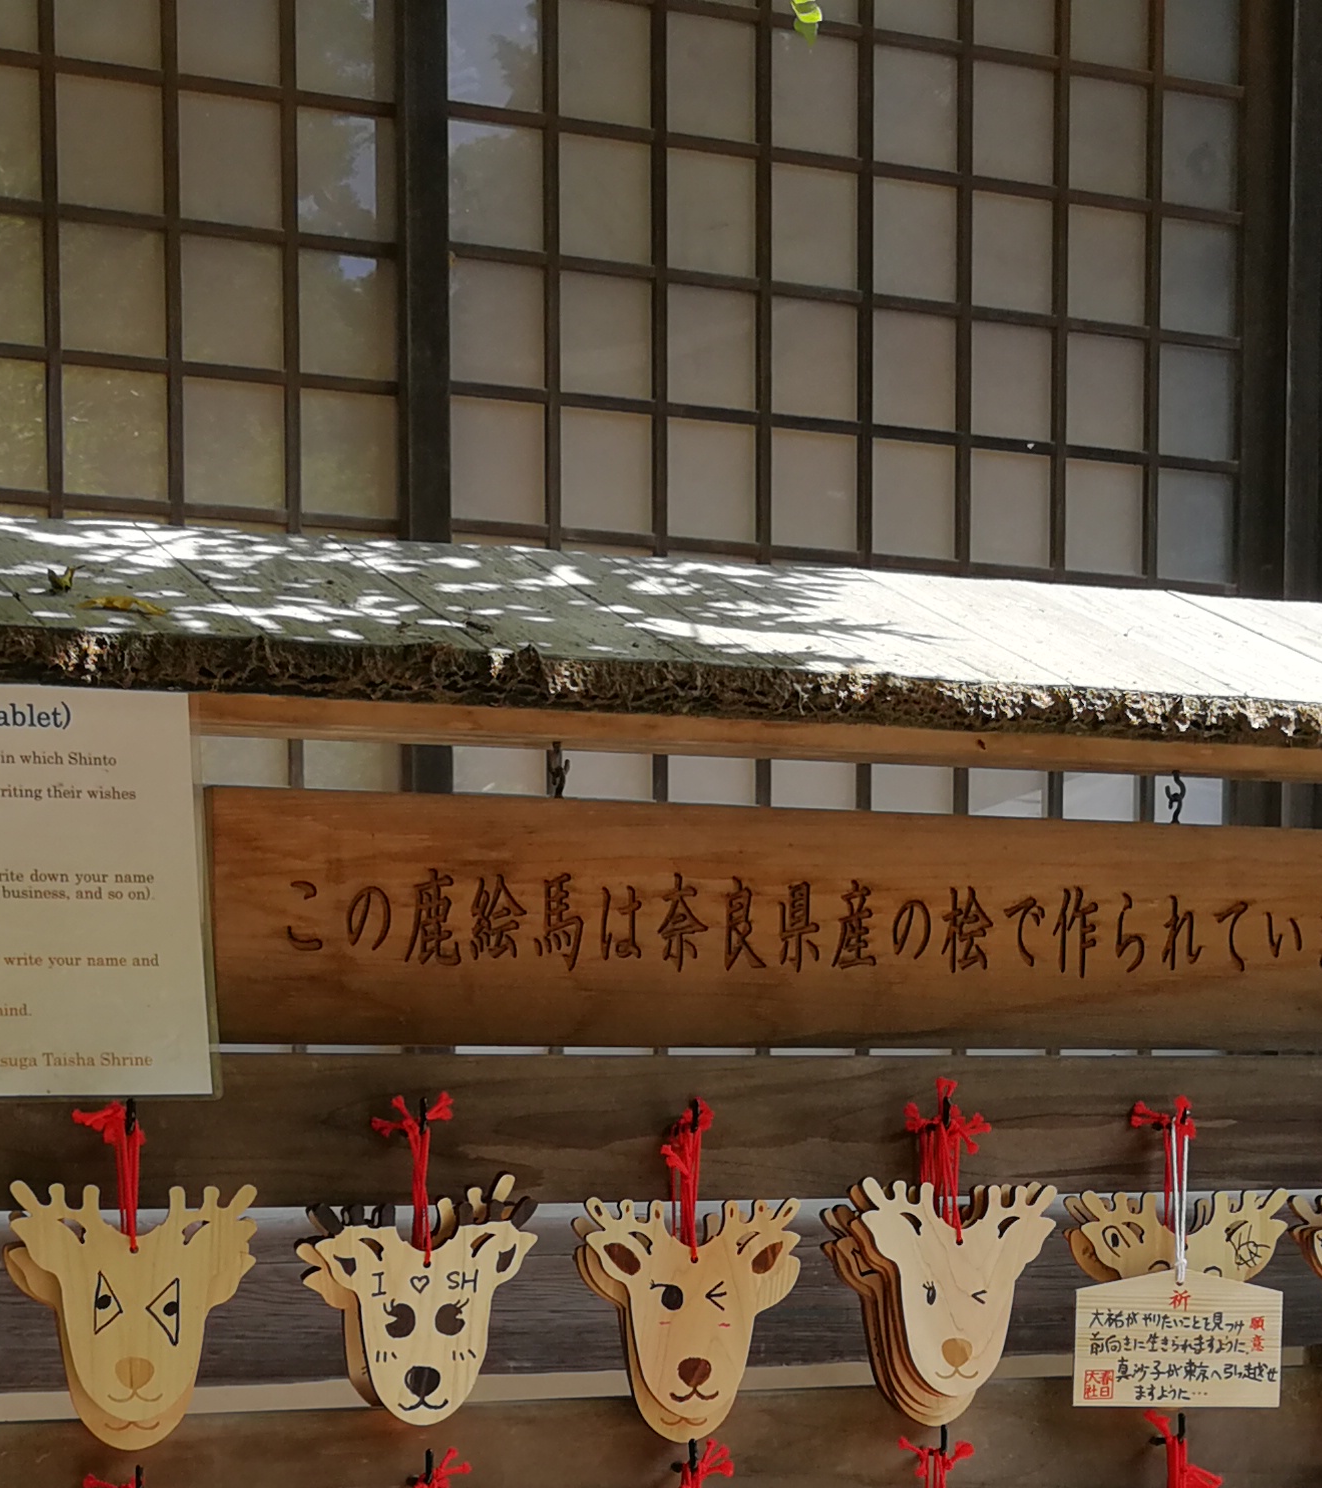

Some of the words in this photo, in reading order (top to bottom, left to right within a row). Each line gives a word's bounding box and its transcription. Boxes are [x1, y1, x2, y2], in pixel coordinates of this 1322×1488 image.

[0, 752, 15, 764] in
[19, 751, 64, 765] which
[68, 751, 117, 766] Shinto
[46, 785, 82, 799] their
[87, 786, 136, 800] wishes
[30, 869, 69, 883] down
[75, 873, 109, 886] your
[114, 874, 154, 884] name
[2, 885, 70, 900] business,
[75, 886, 103, 900] and
[108, 891, 124, 900] so
[128, 886, 154, 901] on).
[41, 1052, 96, 1067] Taisha
[100, 1052, 153, 1067] Shrine
[446, 1268, 479, 1293] SH
[1169, 1290, 1191, 1311] 祈
